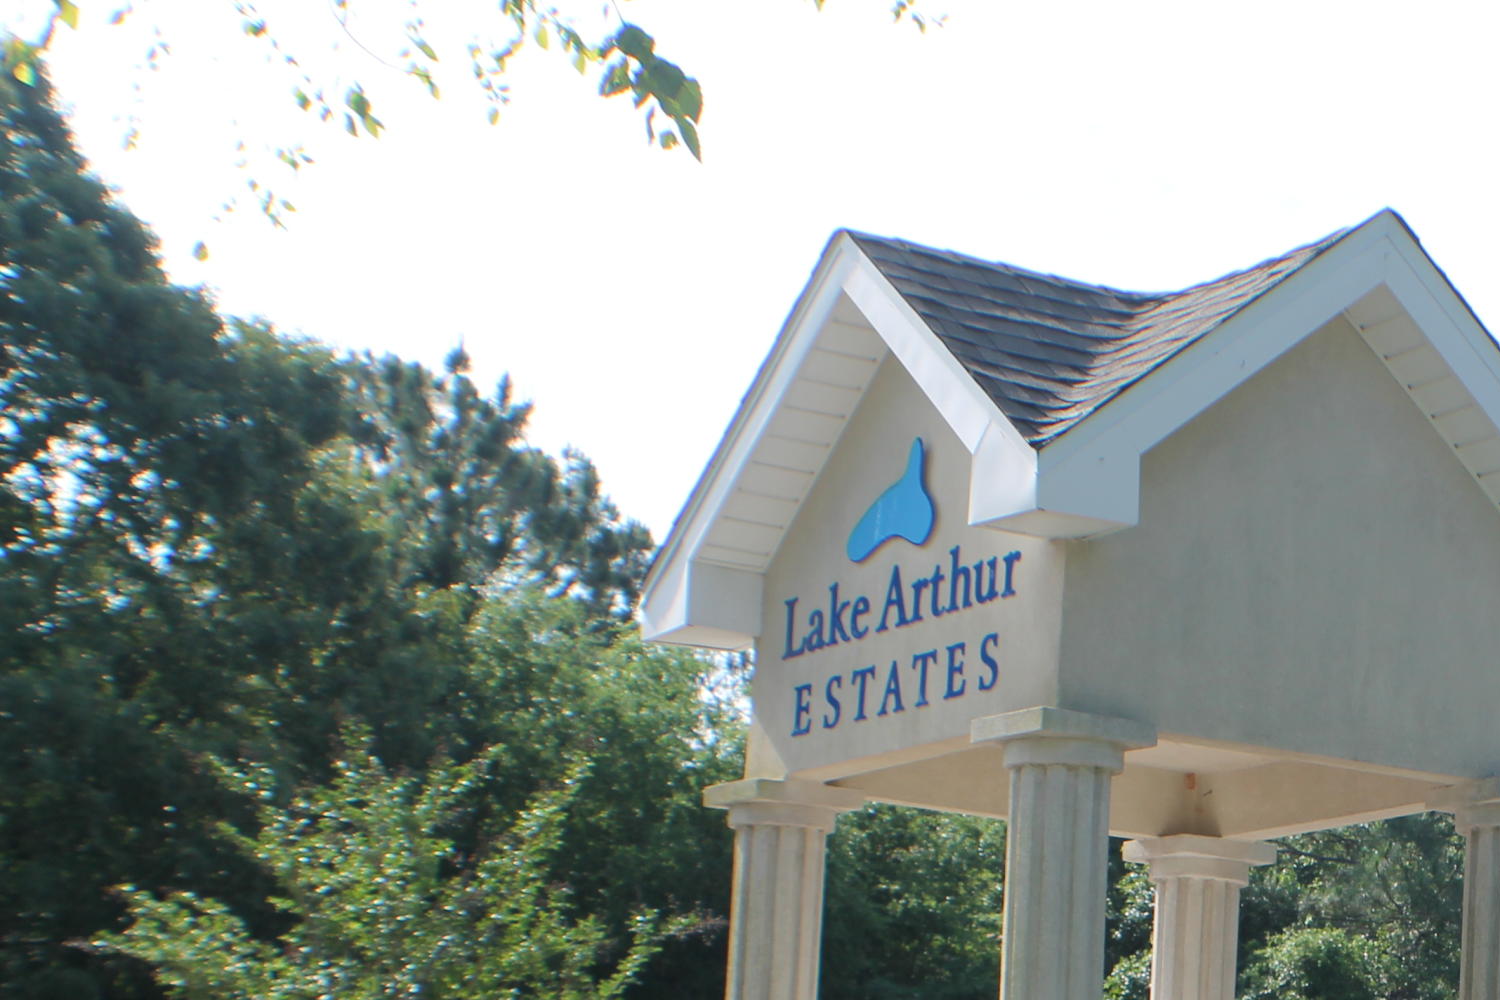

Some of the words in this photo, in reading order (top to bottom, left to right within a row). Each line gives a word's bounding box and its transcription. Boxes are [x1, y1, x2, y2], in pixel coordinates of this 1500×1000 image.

[782, 582, 870, 660] Lake
[875, 545, 1021, 633] Arthur
[791, 633, 999, 737] ESTATES
